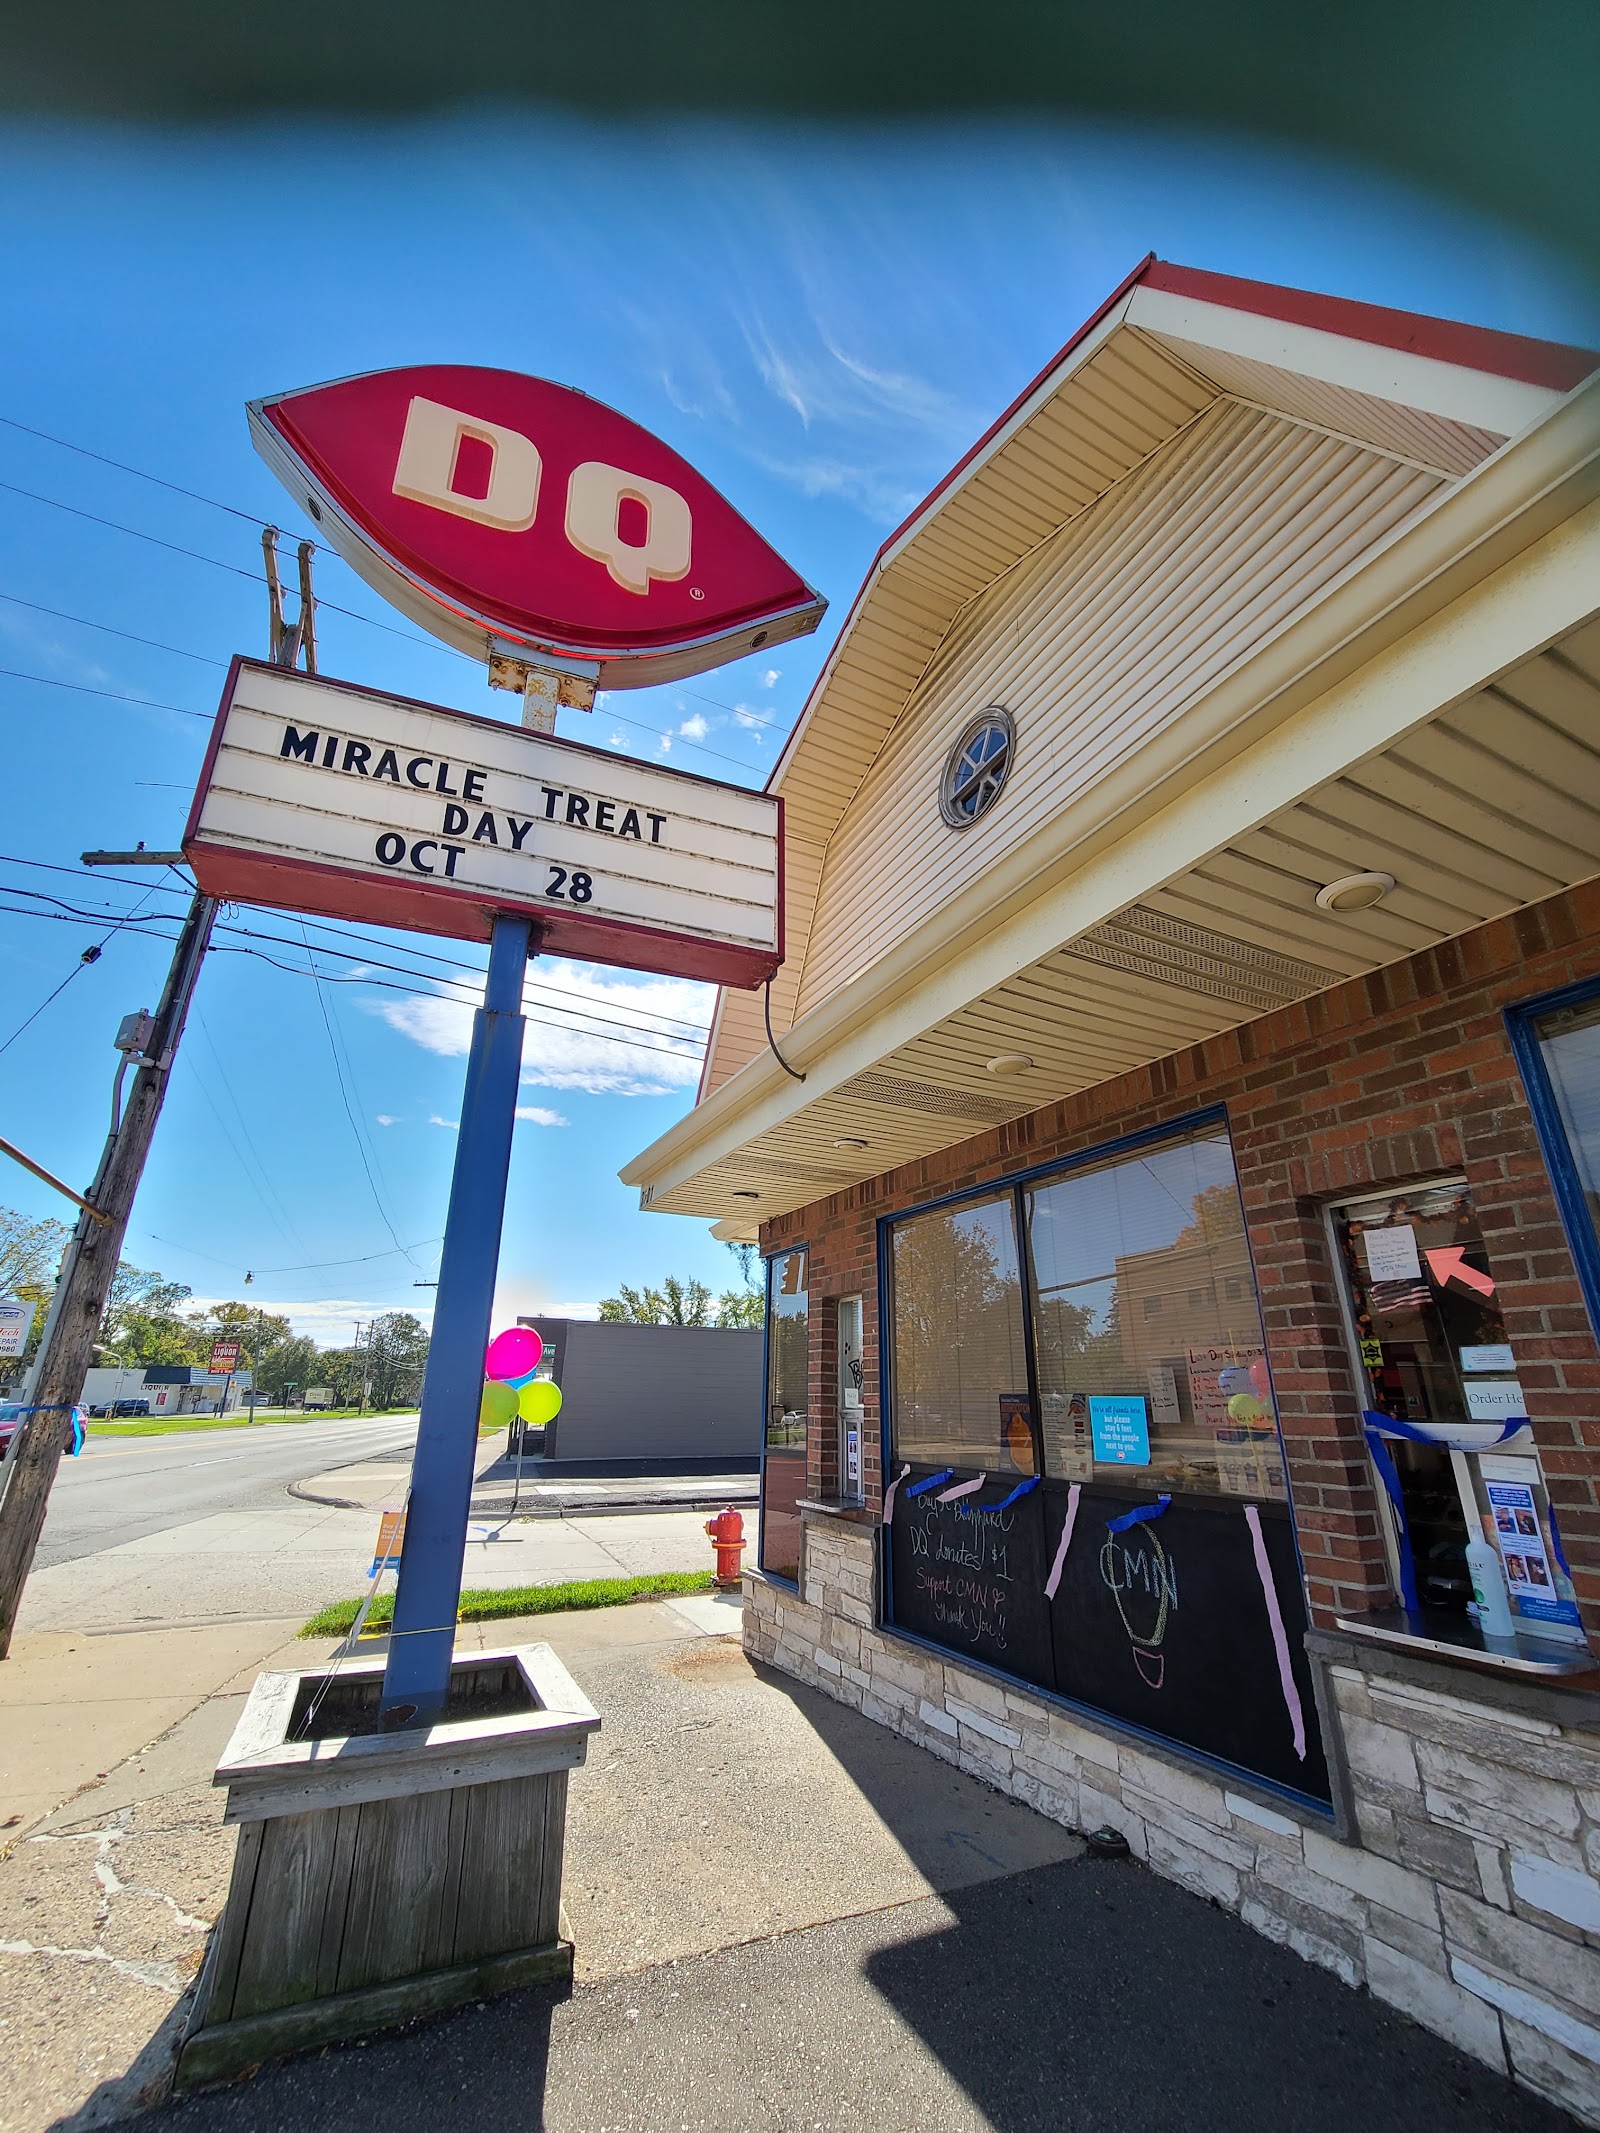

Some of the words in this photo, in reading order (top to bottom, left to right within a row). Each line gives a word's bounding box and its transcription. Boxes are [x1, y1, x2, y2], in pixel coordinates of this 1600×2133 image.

[392, 396, 692, 595] DQ
[280, 726, 487, 802] MIRACLE
[541, 787, 667, 843] TREAT
[442, 803, 534, 850] DAY
[375, 833, 466, 877] OCT
[545, 866, 593, 903] 28
[213, 1348, 237, 1356] LIQUOR
[543, 1347, 556, 1355] Ave
[1469, 1393, 1503, 1404] Order
[1104, 1415, 1113, 1423] but
[1114, 1415, 1131, 1424] please
[1105, 1425, 1116, 1433] stay
[1116, 1424, 1120, 1432] 6
[1100, 1432, 1112, 1440] from
[1112, 1433, 1121, 1441] the
[1122, 1434, 1140, 1443] people
[1117, 1442, 1123, 1450] to
[910, 1526, 930, 1557] DQ
[936, 1534, 982, 1571] donates
[917, 1567, 953, 1600] Support
[956, 1579, 988, 1608] CMN
[1100, 1543, 1178, 1611] CMN
[935, 1603, 968, 1629] Thank
